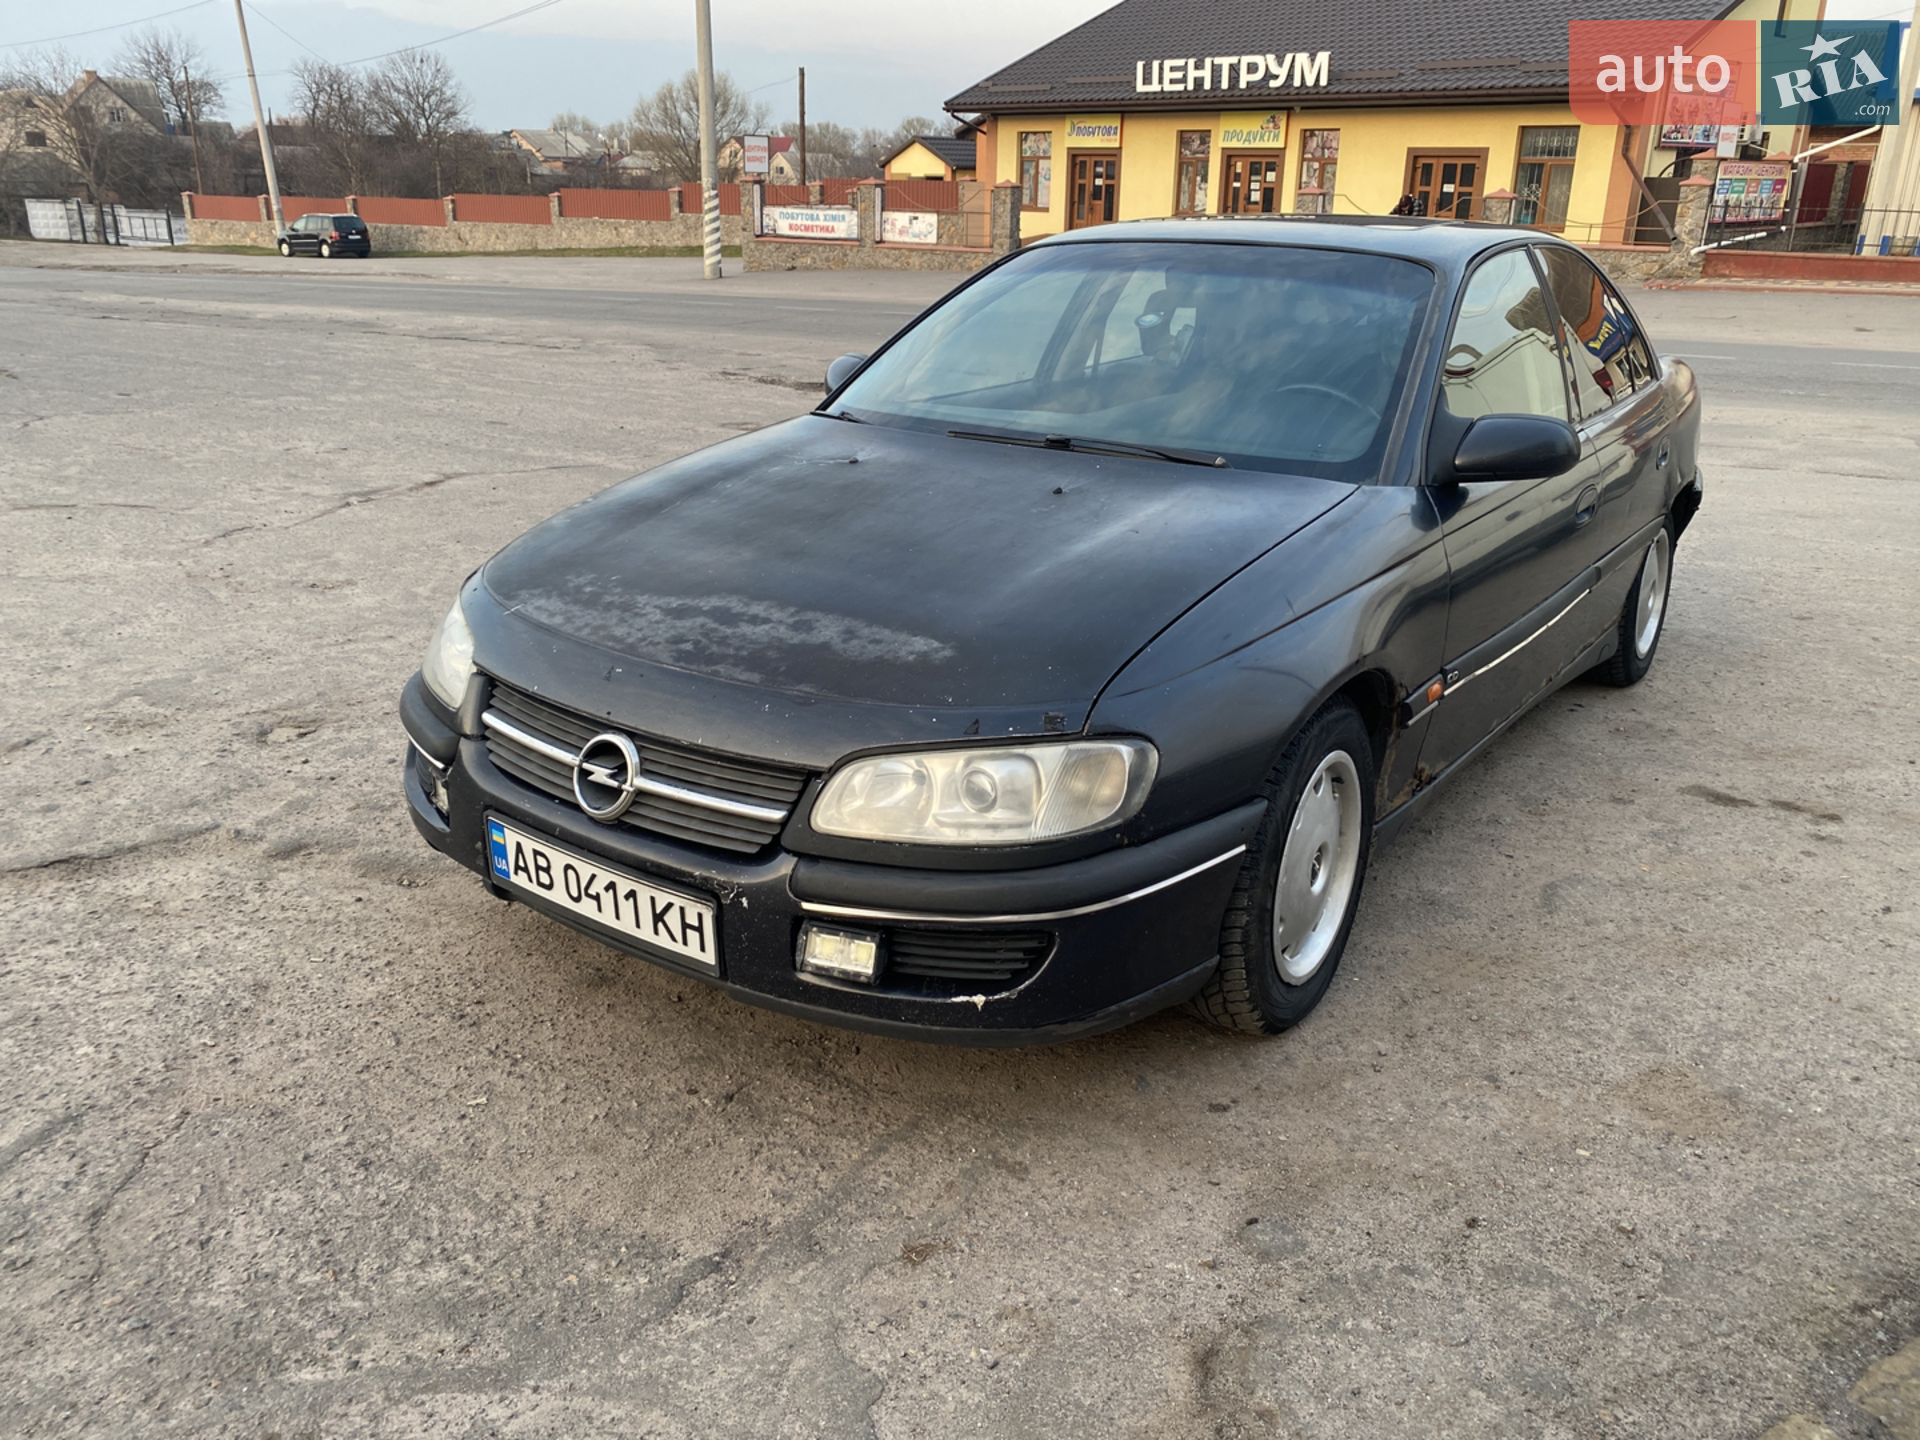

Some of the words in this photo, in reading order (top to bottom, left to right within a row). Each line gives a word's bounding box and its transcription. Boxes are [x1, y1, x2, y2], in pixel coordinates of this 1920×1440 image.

[1136, 51, 1331, 92] ЦЕНТРУМ
[1075, 125, 1119, 138] ПОБУТОВА
[1221, 129, 1280, 145] ПРОДУКТИ
[779, 211, 820, 222] ПОБУТОВА
[823, 213, 846, 222] ХІМІЯ
[788, 223, 835, 234] КОСМЕТИКА
[494, 855, 509, 872] UA
[513, 841, 554, 891] AB
[563, 863, 641, 929] 0411
[649, 895, 706, 953] KH
